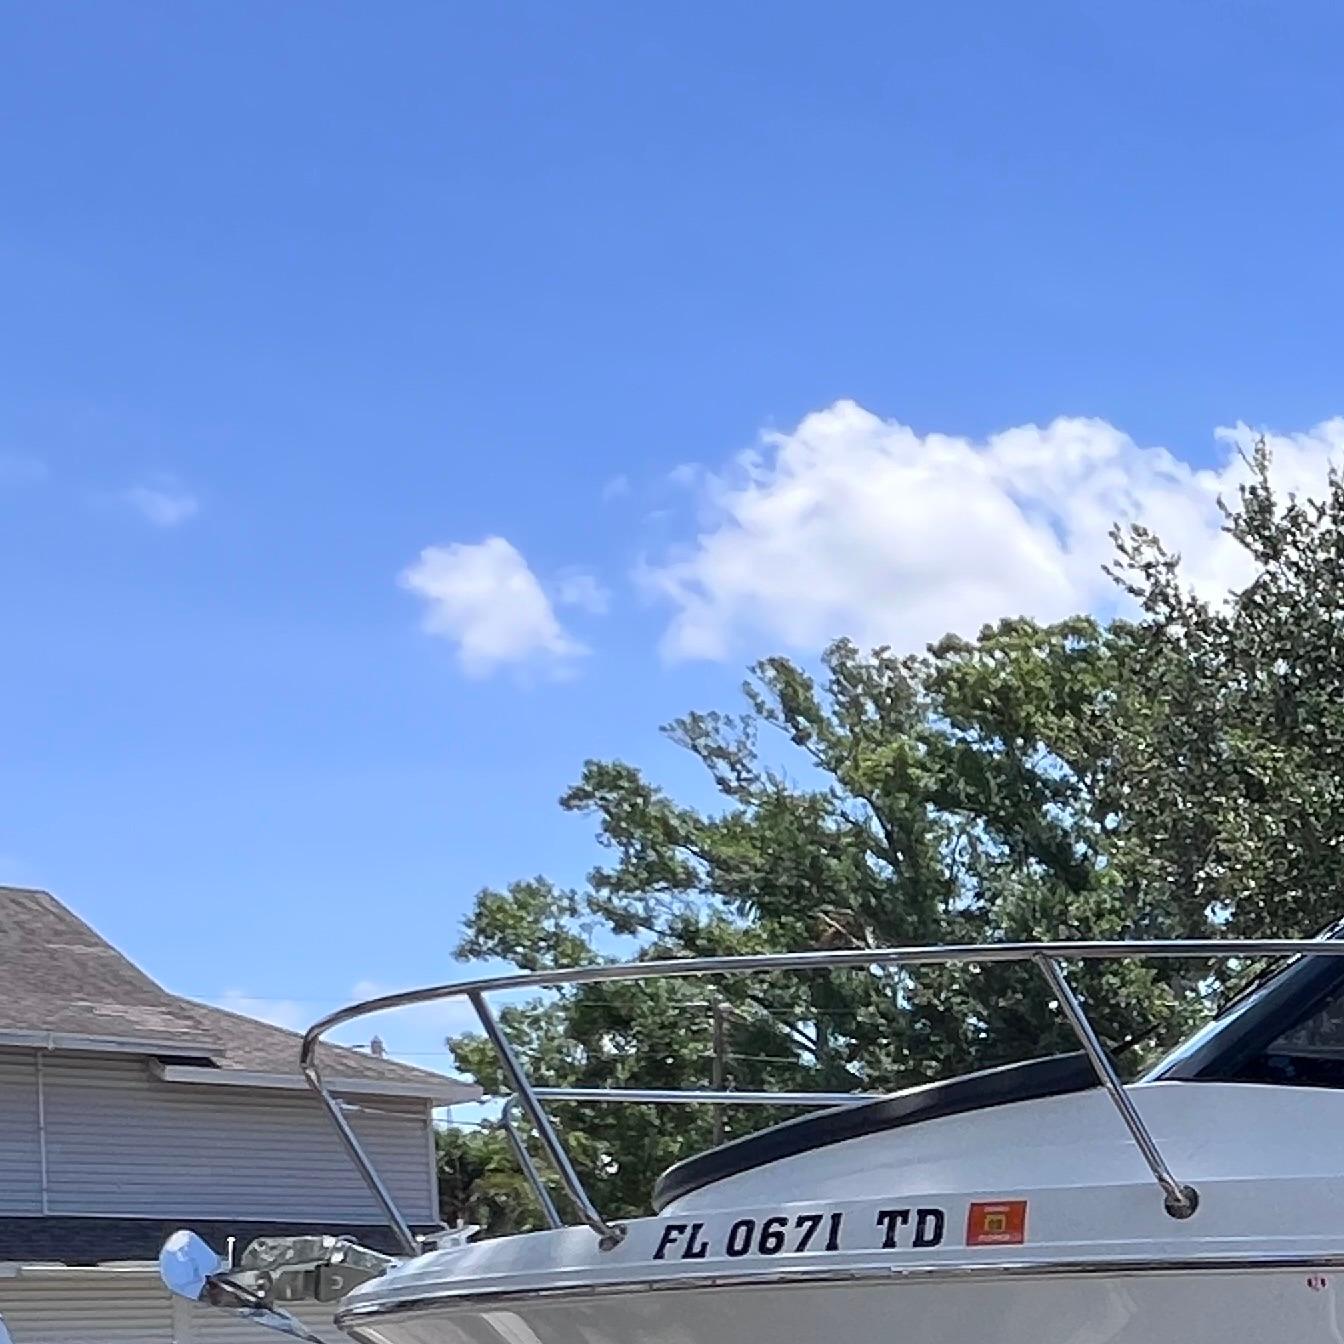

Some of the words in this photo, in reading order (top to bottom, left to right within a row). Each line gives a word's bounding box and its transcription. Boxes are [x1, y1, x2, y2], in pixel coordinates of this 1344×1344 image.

[652, 1222, 709, 1260] FL
[725, 1212, 844, 1258] 0671
[876, 1207, 945, 1250] TD
